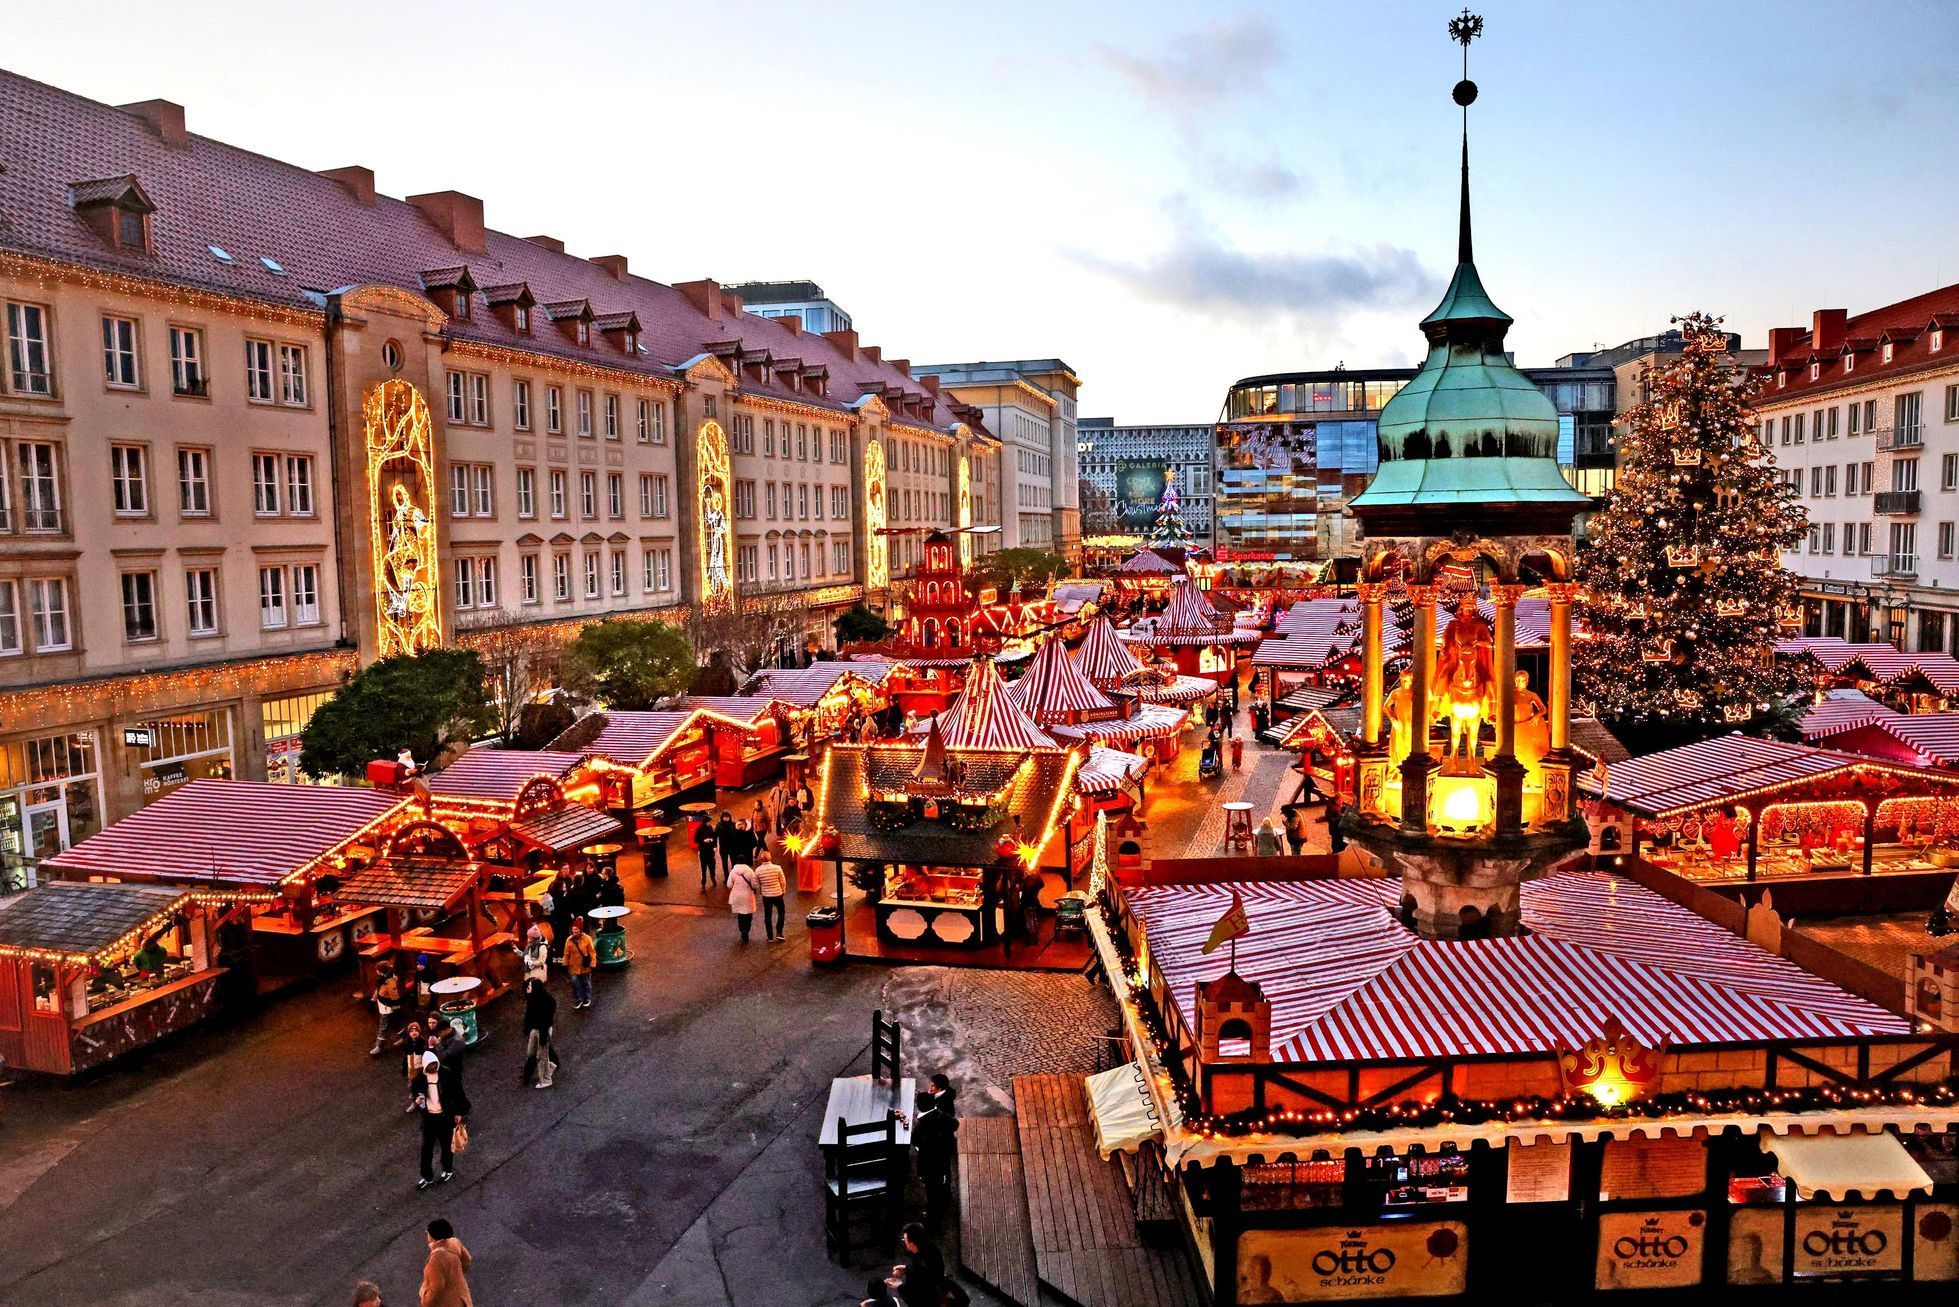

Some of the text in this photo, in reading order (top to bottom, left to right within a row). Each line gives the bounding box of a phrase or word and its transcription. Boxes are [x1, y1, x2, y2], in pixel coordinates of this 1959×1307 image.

[1232, 552, 1276, 560] Sparkasse
[163, 772, 182, 780] KAFFEE
[1811, 1257, 1876, 1268] schänke
[1319, 1275, 1385, 1287] schänke
